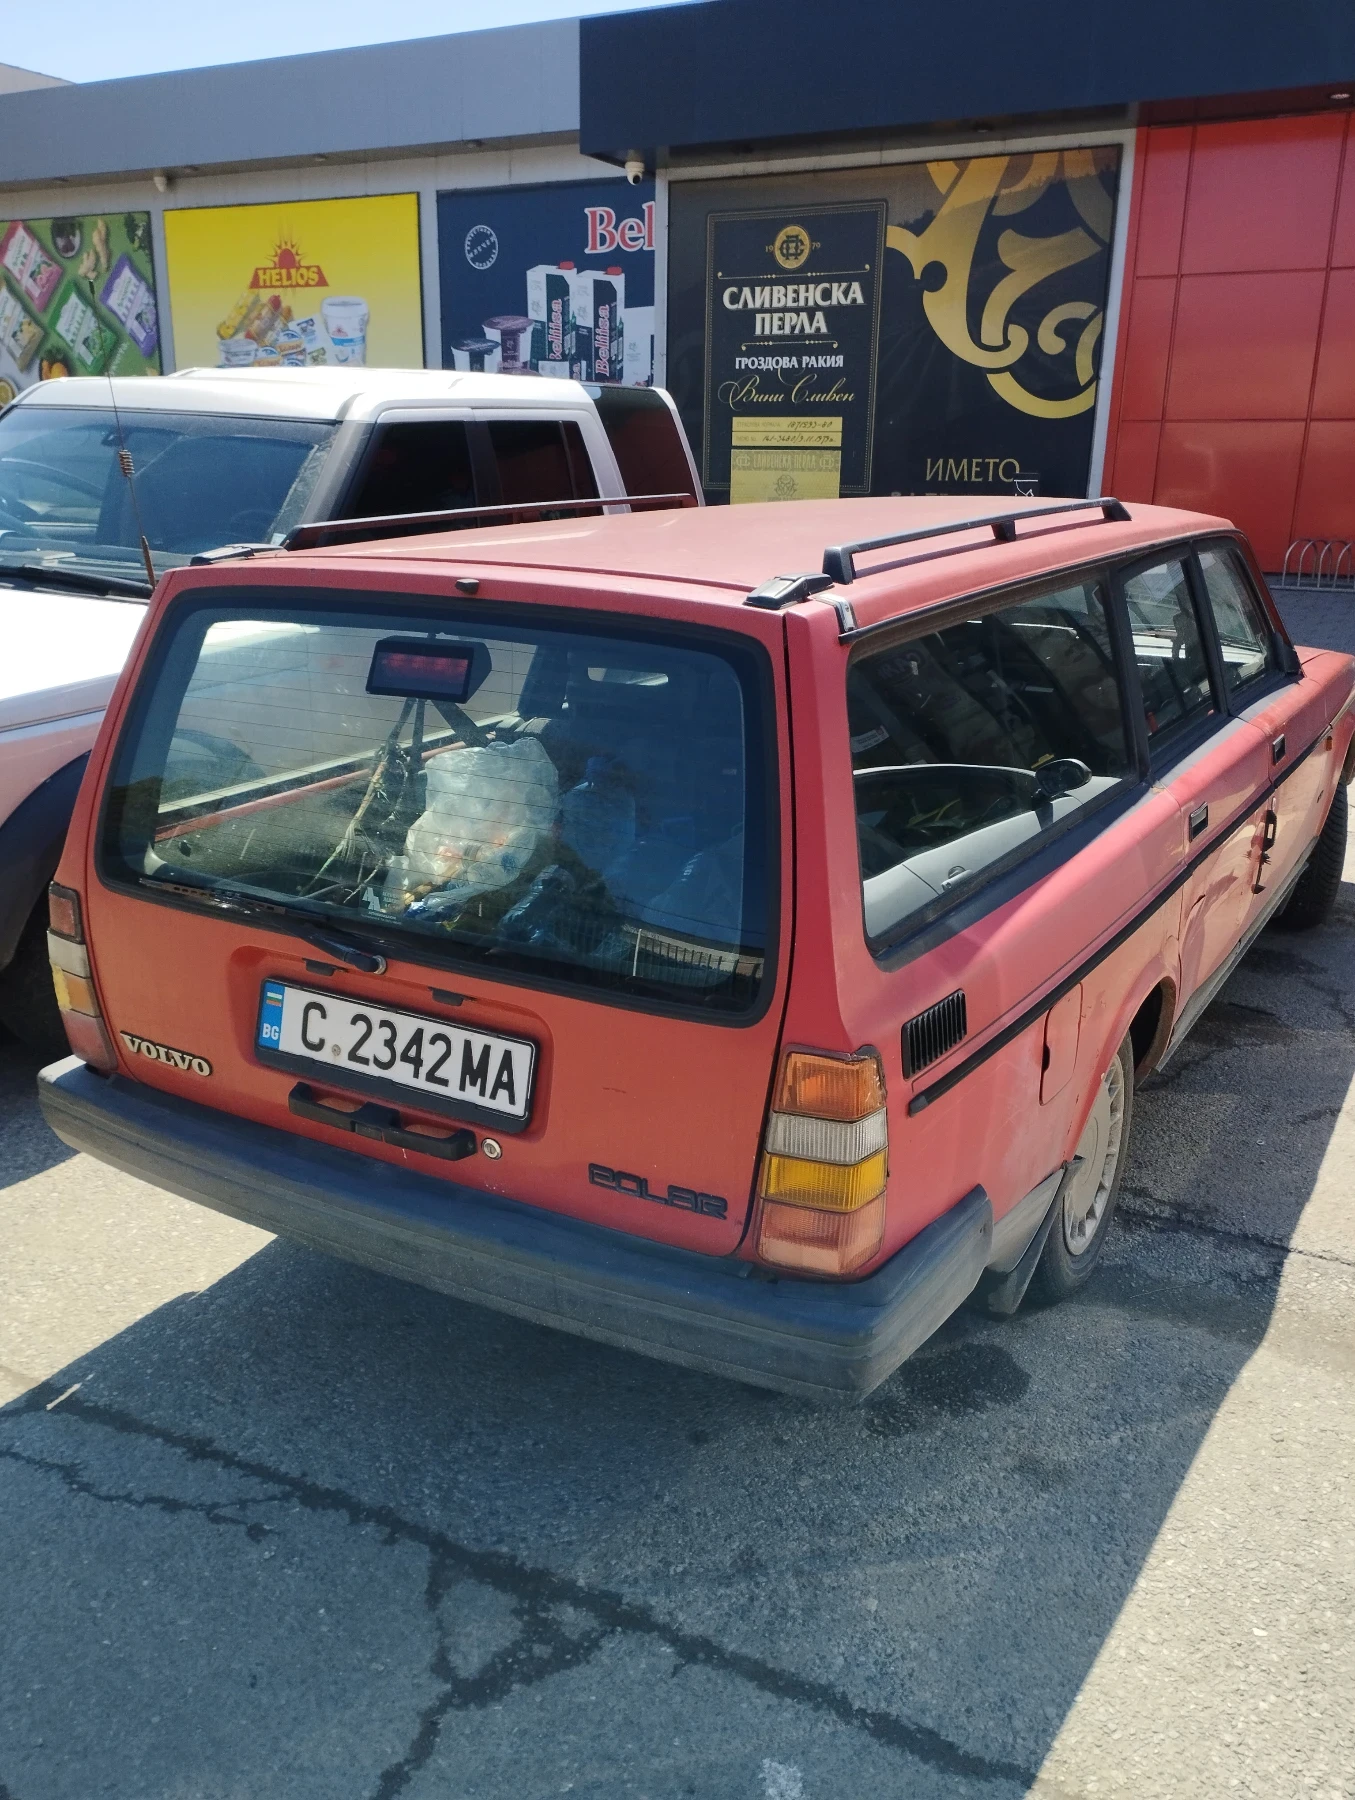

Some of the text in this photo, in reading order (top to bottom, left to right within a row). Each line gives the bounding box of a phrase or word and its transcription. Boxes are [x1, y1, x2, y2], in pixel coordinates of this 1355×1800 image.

[765, 245, 774, 253] 19
[257, 266, 320, 287] HELIOS
[722, 281, 866, 311] СЛИВЕНСКА
[754, 311, 829, 335] ПЕРЛА
[595, 304, 610, 378] Bellisa
[735, 355, 844, 371] ГРОЗДОВА РАКИЯ
[925, 458, 1020, 483] ИМЕТО
[262, 1022, 280, 1041] BG
[120, 1030, 213, 1077] VOLVO
[588, 1162, 728, 1221] POLAR
